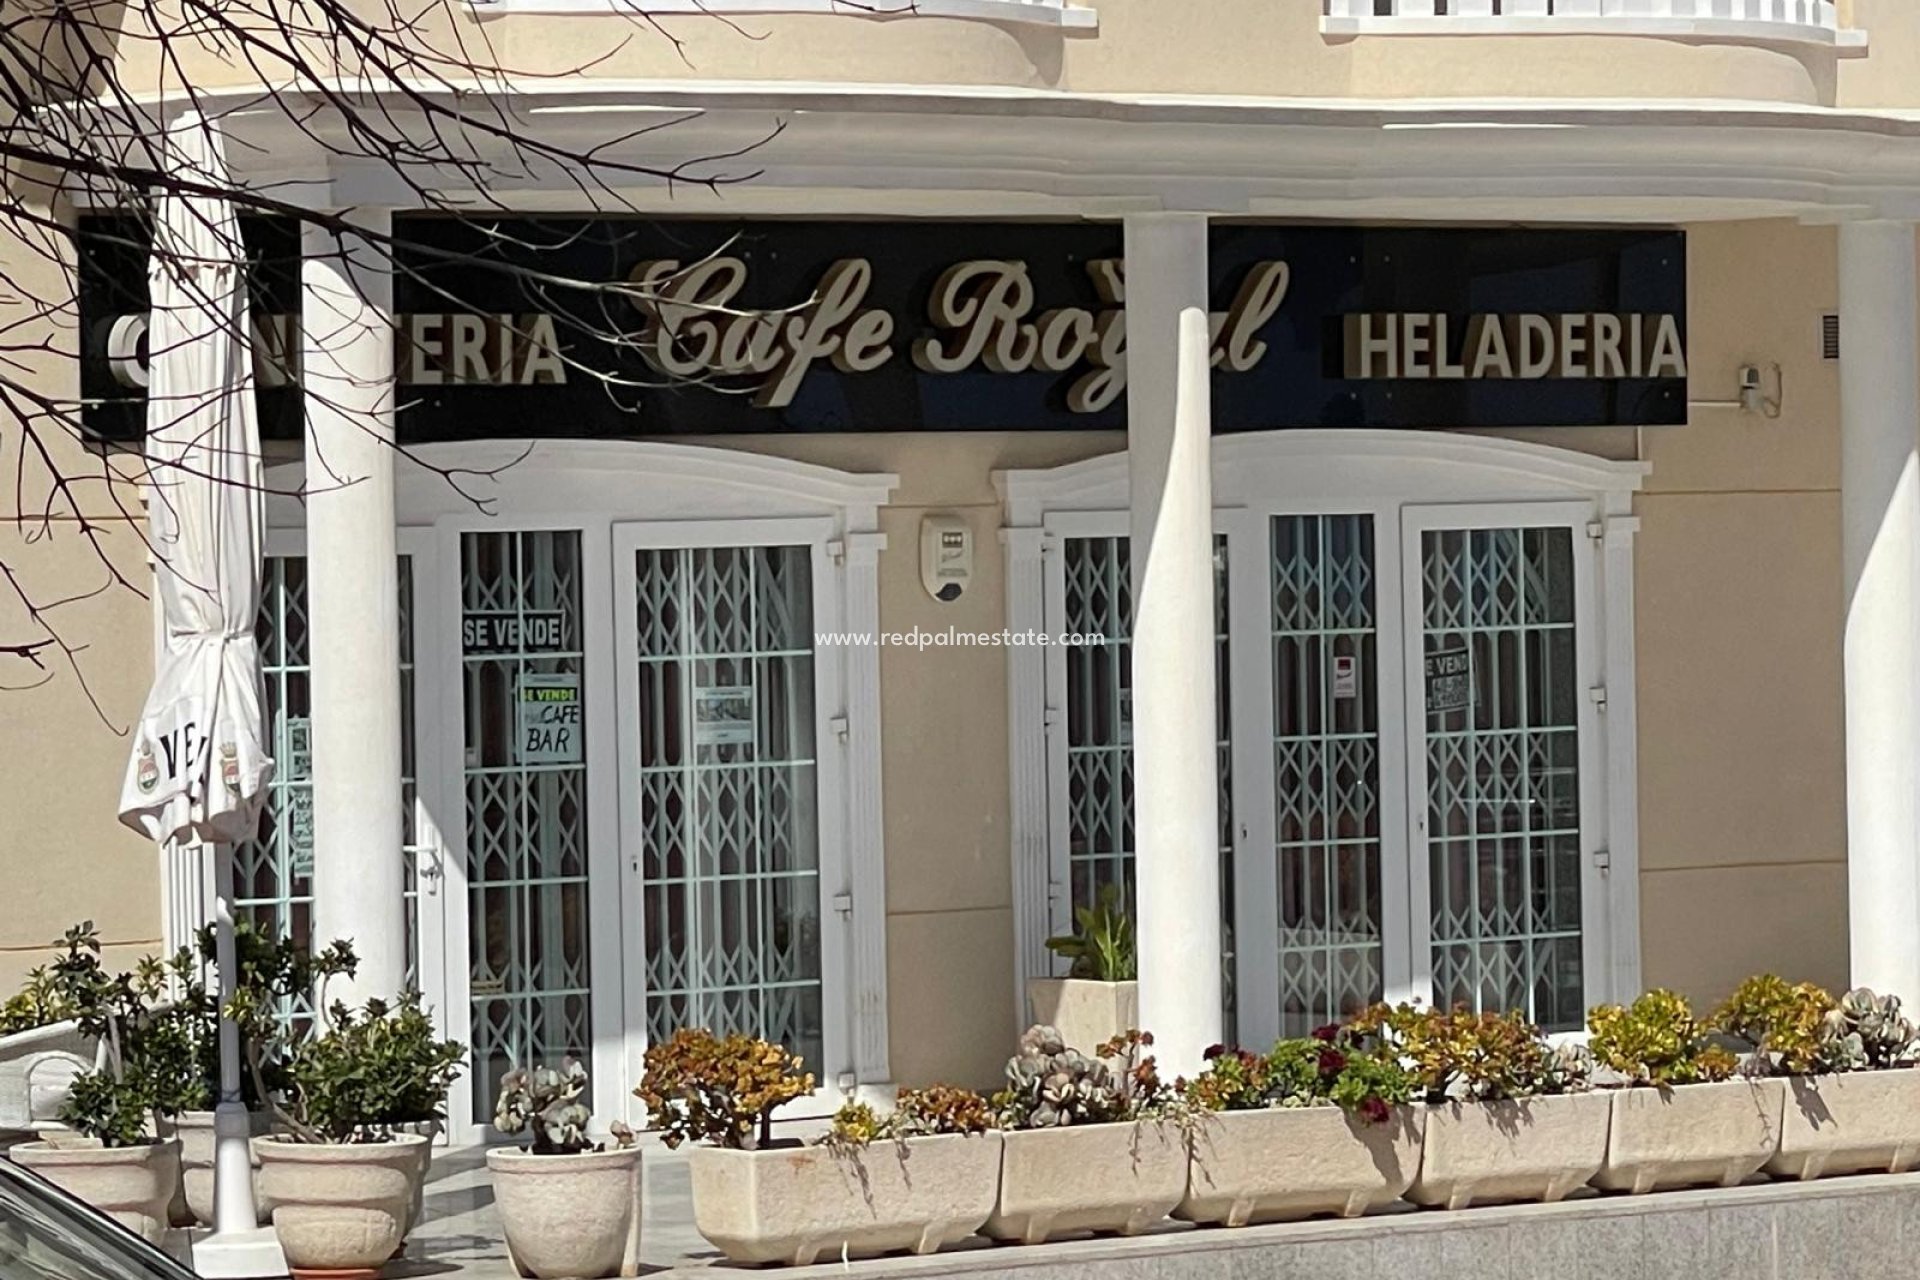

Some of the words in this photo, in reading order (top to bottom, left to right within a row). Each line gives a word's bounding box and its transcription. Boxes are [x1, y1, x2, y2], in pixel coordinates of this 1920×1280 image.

[630, 257, 894, 408] Cafe
[1350, 312, 1687, 378] HELADERIA
[463, 619, 488, 646] SE
[493, 618, 560, 646] VENDE
[541, 704, 579, 724] CAFE
[526, 727, 570, 753] BAR
